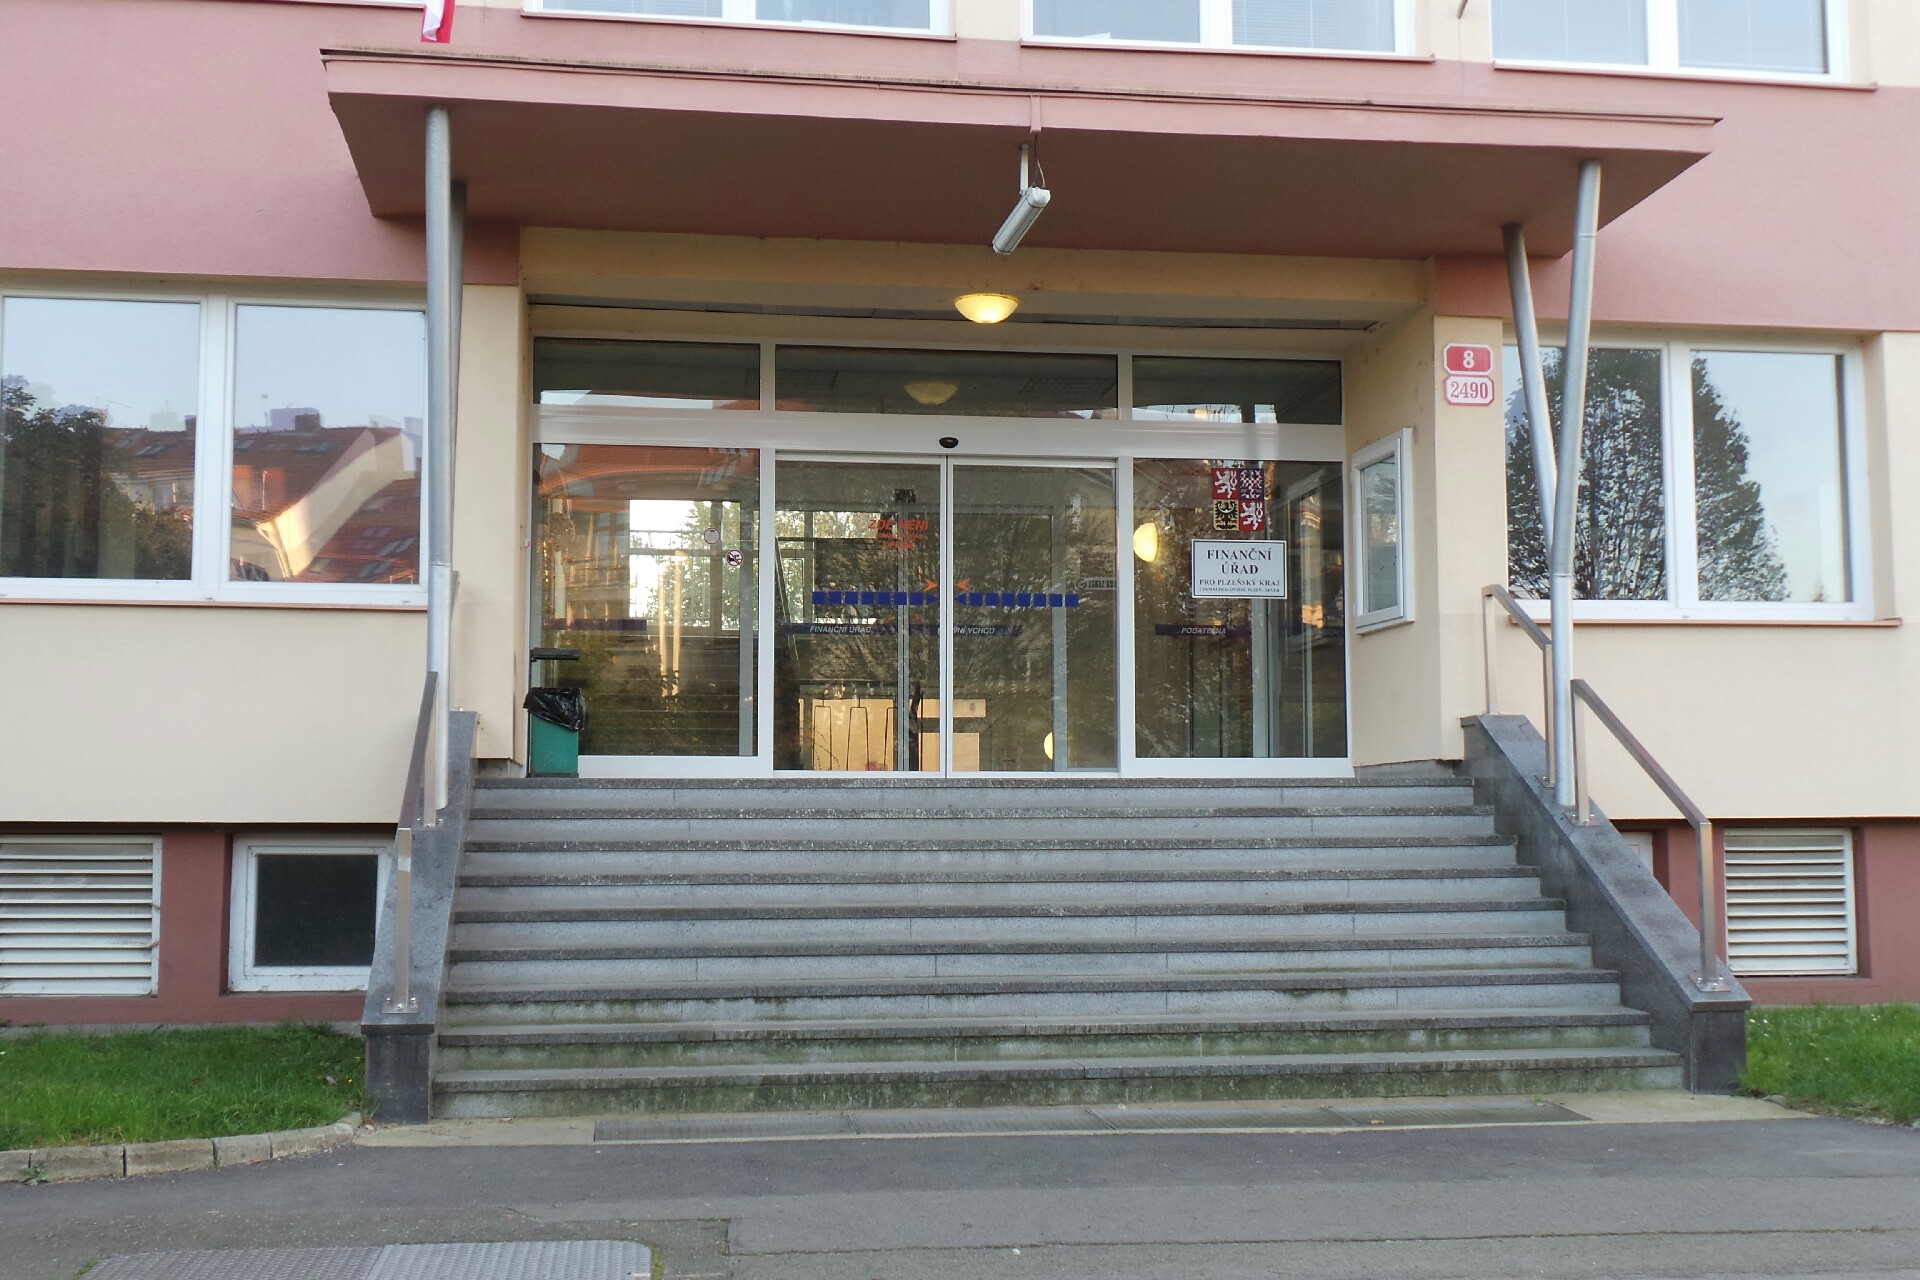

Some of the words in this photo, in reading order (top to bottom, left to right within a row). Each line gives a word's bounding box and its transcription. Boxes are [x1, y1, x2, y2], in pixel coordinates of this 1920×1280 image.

[1463, 350, 1475, 368] 8
[1450, 381, 1489, 399] 2490
[868, 519, 894, 530] ZDE
[1207, 547, 1273, 561] FINANČNÍ
[1221, 561, 1258, 575] ÚŘAD
[1217, 578, 1257, 586] PLZEŇSKÝ
